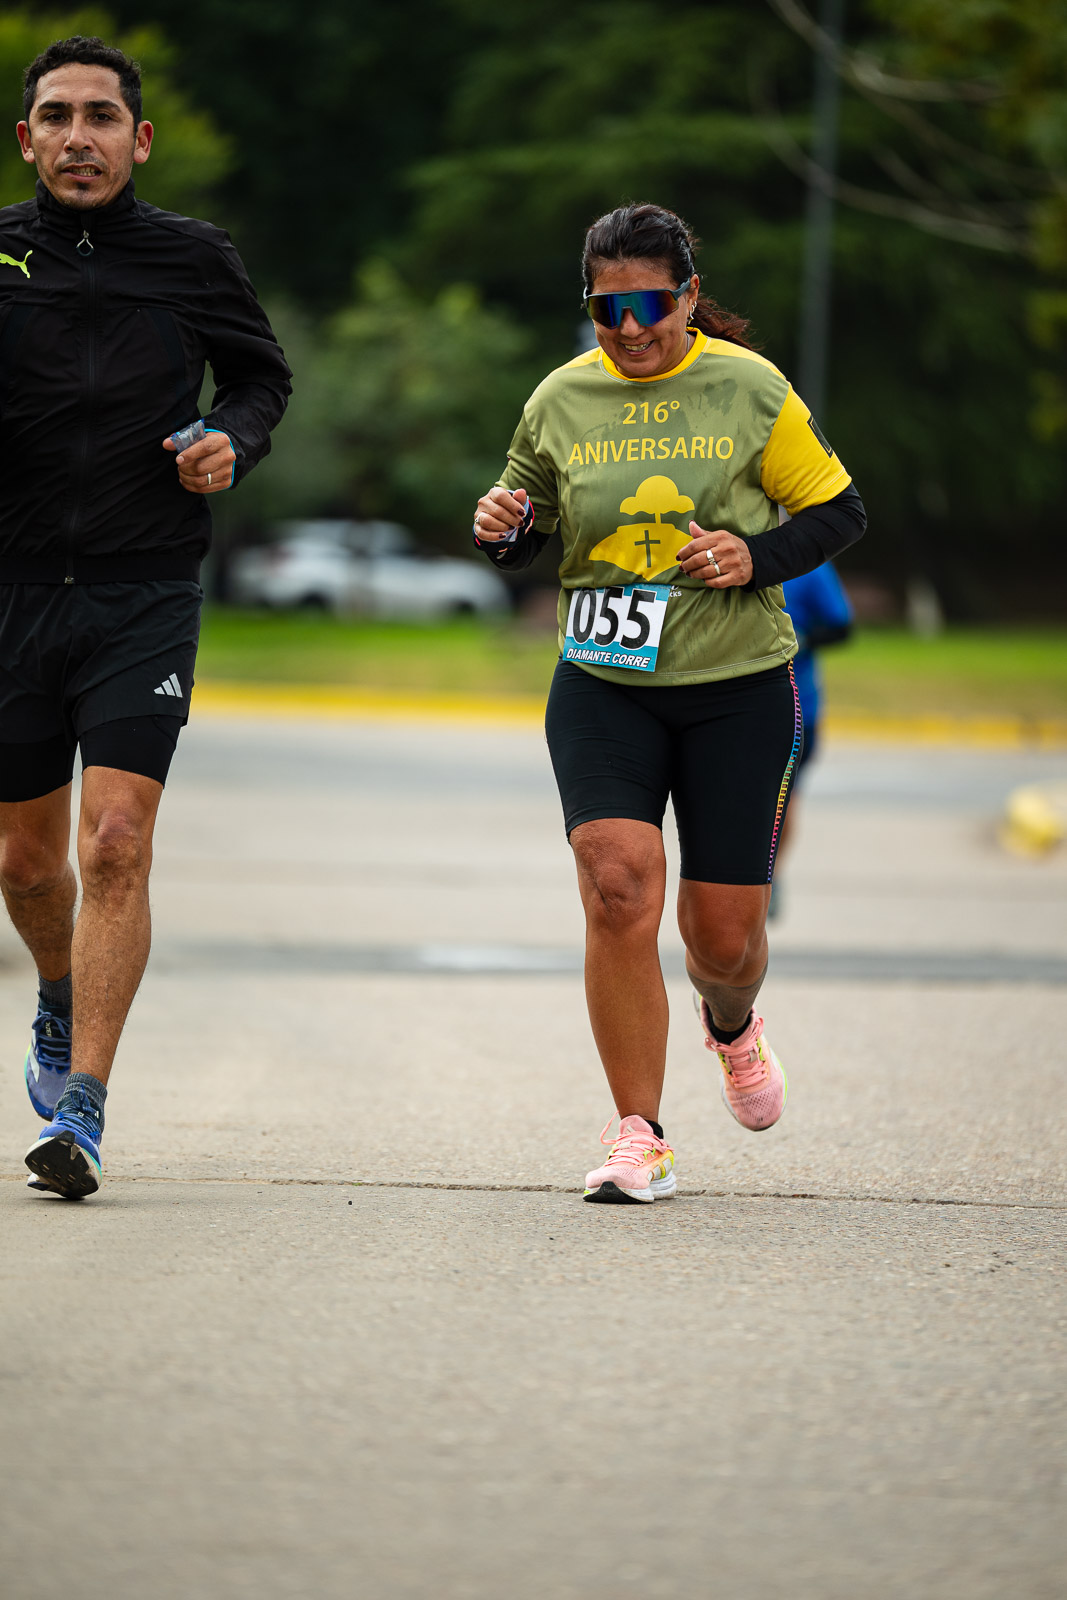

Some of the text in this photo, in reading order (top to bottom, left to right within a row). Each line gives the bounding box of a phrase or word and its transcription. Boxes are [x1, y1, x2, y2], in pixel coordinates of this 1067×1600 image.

[622, 400, 680, 425] 216°
[567, 436, 734, 465] ANIVERSARIO
[573, 586, 657, 650] 055
[566, 648, 651, 668] DIAMANTE CORRE
